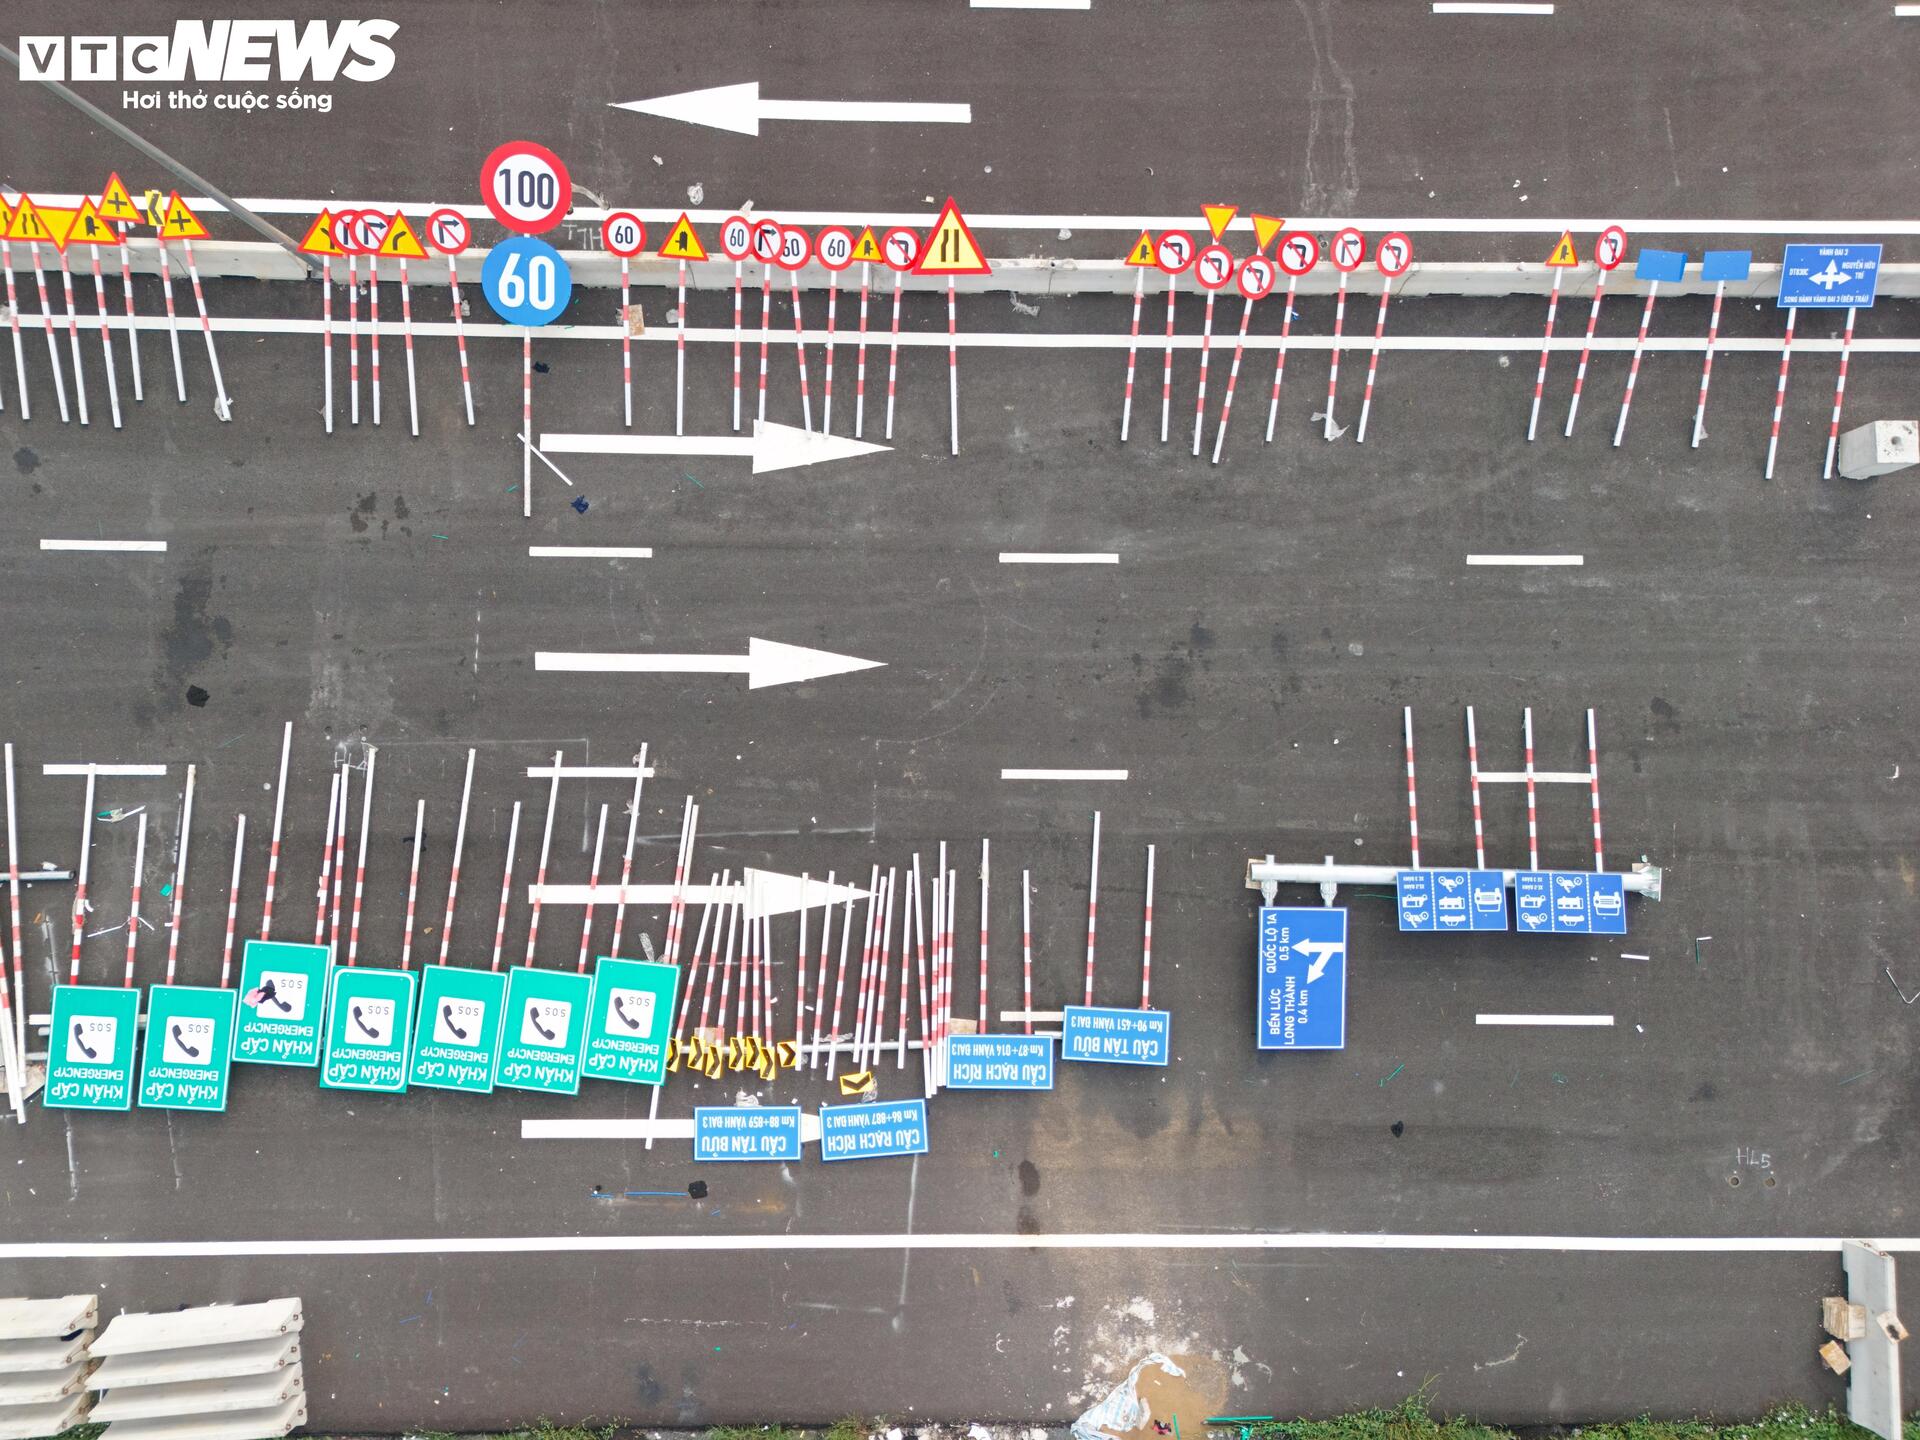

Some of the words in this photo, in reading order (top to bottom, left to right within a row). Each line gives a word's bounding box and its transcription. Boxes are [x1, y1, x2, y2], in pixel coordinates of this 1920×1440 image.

[499, 169, 554, 210] 100
[615, 225, 633, 244] 60
[730, 228, 744, 247] 60
[783, 238, 800, 257] 60
[828, 239, 845, 257] 60
[498, 253, 555, 311] 60
[1267, 913, 1277, 924] 1A
[1264, 928, 1278, 941] LỘ
[1280, 927, 1290, 944] km
[1262, 944, 1277, 974] QUỐC
[1280, 946, 1289, 961] 0.5
[1268, 988, 1280, 1010] LỨC
[1283, 976, 1295, 1013] THÀNH
[1298, 990, 1308, 1006] km
[1093, 1017, 1115, 1032] VÀNH
[1117, 1018, 1148, 1031] 90+451
[1150, 1019, 1163, 1032] Km
[1266, 1012, 1280, 1035] BẾN
[1298, 1009, 1308, 1024] 0.4
[244, 1021, 313, 1036] EMERGENCYP
[1284, 1015, 1294, 1045] LONG
[241, 1037, 269, 1055] CẤP
[272, 1039, 313, 1059] KHẨN
[332, 1048, 400, 1062] EMERGENCYP
[420, 1046, 488, 1063] EMERGENCYP
[592, 1039, 659, 1054] EMERGENCYP
[973, 1044, 995, 1059] VÀNH
[997, 1043, 1029, 1056] 87+014
[1029, 1044, 1043, 1056] Km
[1073, 1036, 1100, 1056] BỬU
[1104, 1038, 1128, 1056] TÂN
[1133, 1038, 1159, 1060] CẦU
[507, 1047, 575, 1064] EMERGENCYP
[589, 1052, 616, 1070] CẤP
[53, 1067, 124, 1080] EMERGENCYP
[148, 1067, 219, 1081] EMERGENCYP
[329, 1064, 357, 1083] CẤP
[360, 1065, 400, 1085] KHẨN
[417, 1061, 445, 1081] CẤP
[447, 1064, 487, 1084] KHẨN
[504, 1062, 531, 1081] CẤP
[621, 1057, 658, 1076] KHẨN
[953, 1063, 981, 1084] RÍCH
[985, 1063, 1019, 1081] RẠCH
[1022, 1065, 1046, 1086] CẦU
[533, 1066, 574, 1086] KHẨN
[51, 1082, 80, 1099] CẤP
[83, 1084, 123, 1104] KHẨN
[146, 1082, 174, 1101] CẤP
[177, 1084, 218, 1104] KHẨN
[724, 1116, 747, 1131] VÀNH
[749, 1116, 780, 1128] 88+859
[781, 1116, 795, 1128] Km
[827, 1117, 832, 1128] 3
[834, 1116, 847, 1127] ĐAI
[849, 1115, 871, 1130] VÀNH
[872, 1110, 903, 1125] 86+887
[903, 1109, 918, 1122] Km
[701, 1135, 728, 1158] BỬU
[732, 1136, 757, 1153] TÂN
[761, 1136, 786, 1156] CẦU
[828, 1133, 856, 1155] RÍCH
[860, 1130, 893, 1148] RẠCH
[896, 1129, 920, 1152] CẦU
[1736, 1147, 1771, 1168] HL5
